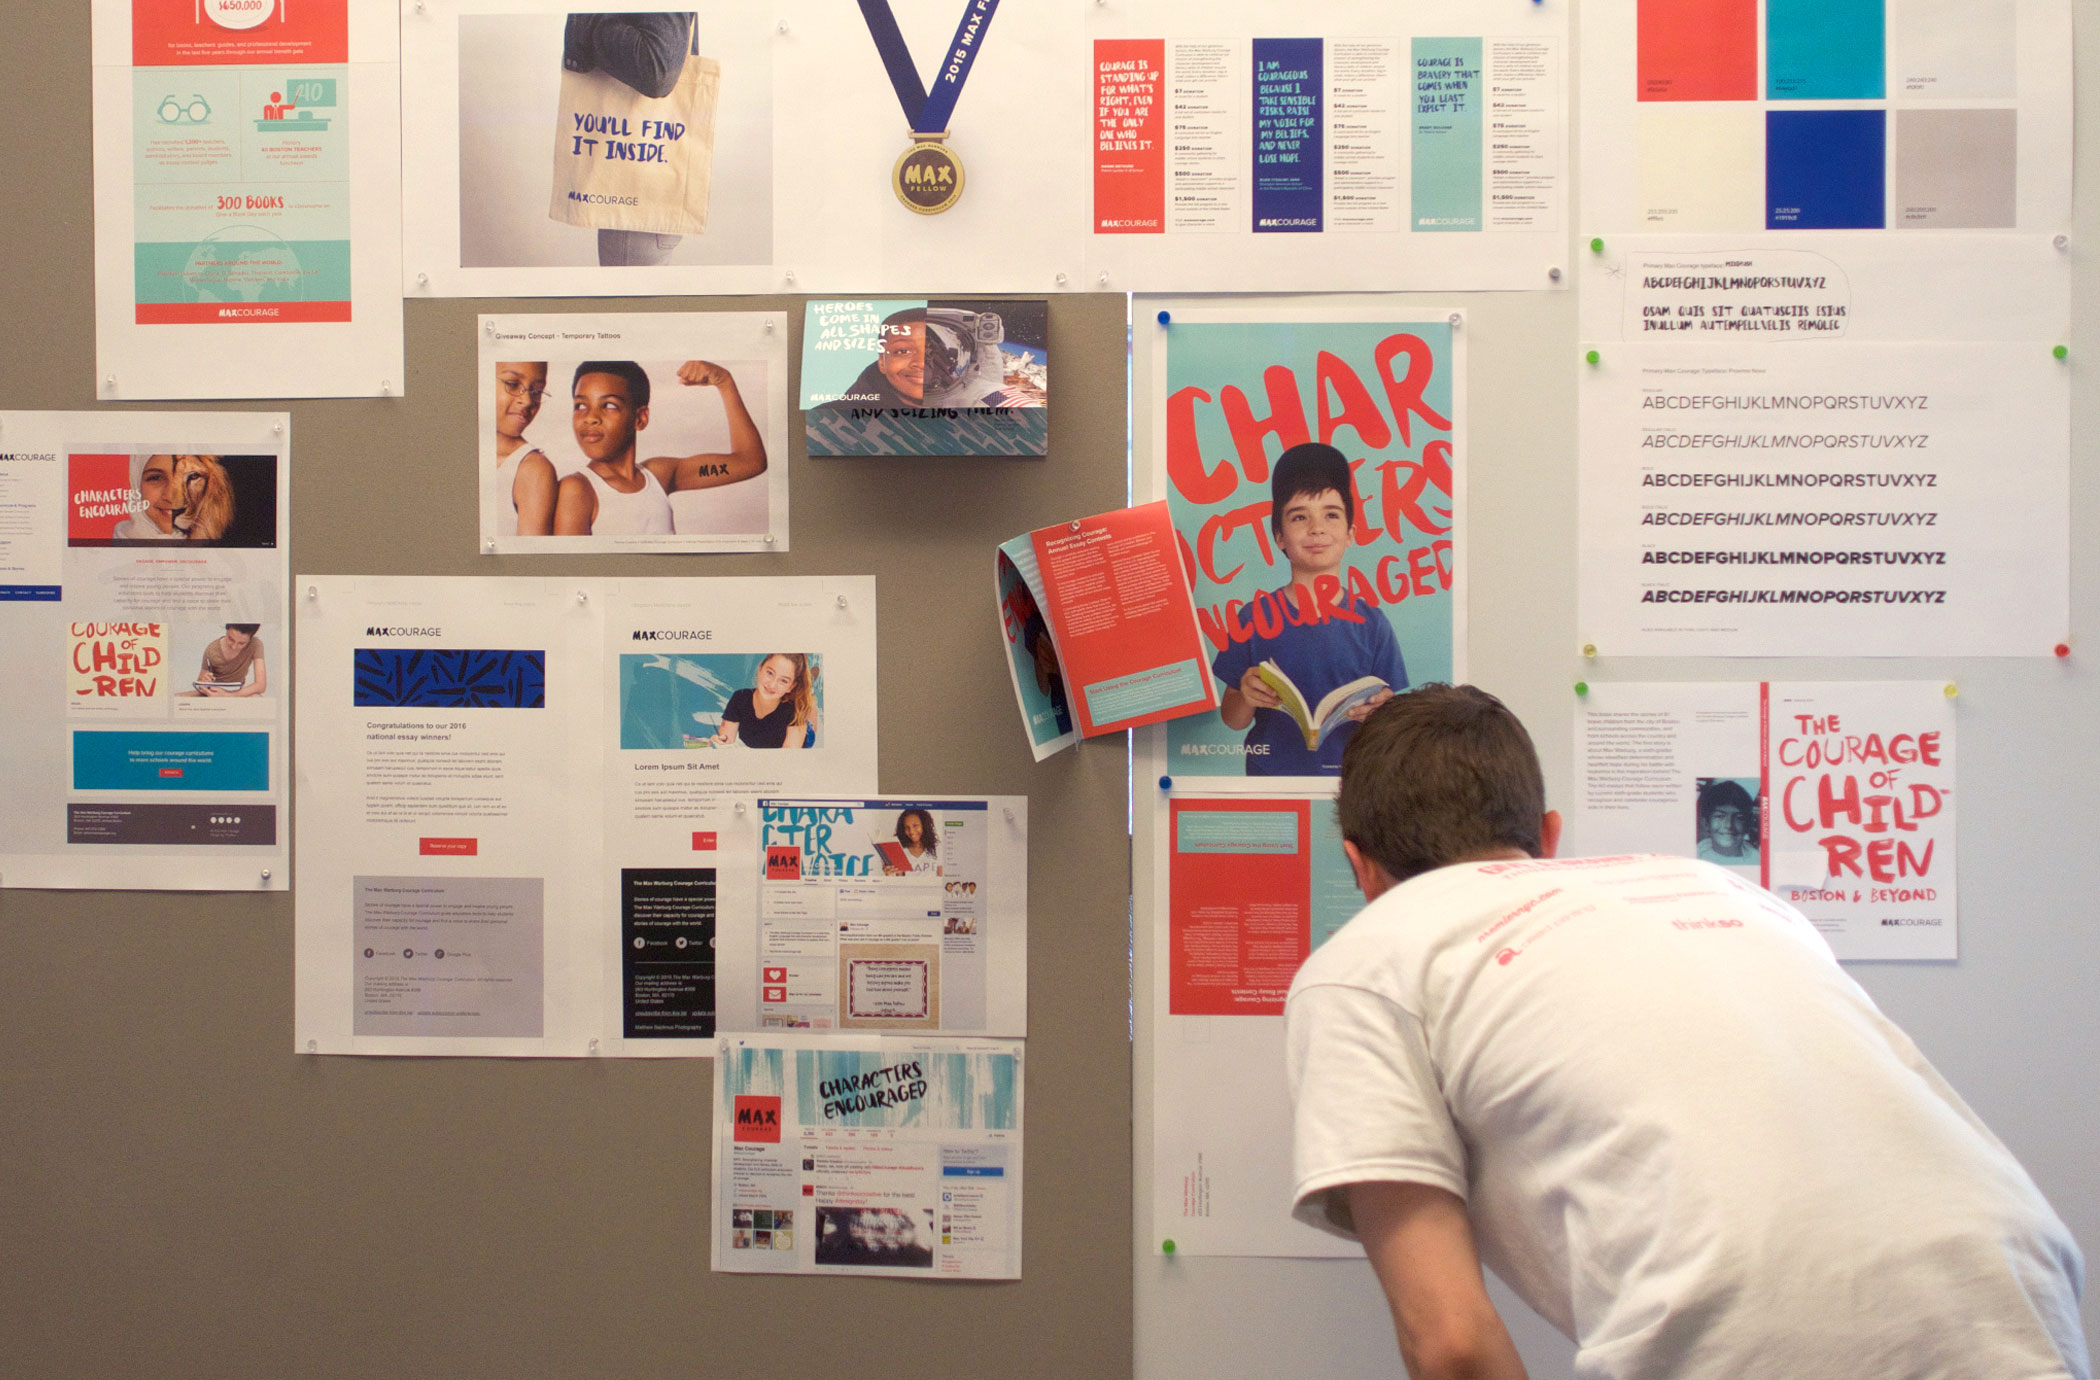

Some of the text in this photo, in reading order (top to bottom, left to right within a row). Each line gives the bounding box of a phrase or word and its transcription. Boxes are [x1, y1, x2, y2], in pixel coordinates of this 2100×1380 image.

[945, 48, 967, 83] 2015
[961, 13, 983, 46] MAX
[1100, 60, 1148, 71] COURAGE IS
[1259, 61, 1279, 71] I AM
[1417, 57, 1464, 67] COURAGE IS
[1101, 71, 1159, 83] STANDING UP
[1258, 70, 1308, 81] COURAGEOUS
[1417, 70, 1480, 80] BRAVERY THAT
[1101, 84, 1154, 95] FOR WHAT'S
[1260, 83, 1301, 94] BECAUSE I
[1418, 81, 1468, 91] COMES WHEN
[1100, 95, 1153, 106] RIGHT, EVEN
[1259, 96, 1316, 106] TAKE SENSIBLE
[1419, 94, 1465, 104] YOU LEAST
[1099, 107, 1149, 116] IF YOU ARE
[1287, 107, 1310, 115] RAISE
[1417, 104, 1447, 113] EXPECT
[574, 112, 685, 140] YOU'LL FIND
[1100, 118, 1144, 128] THE ONLY
[1259, 118, 1315, 128] MY VOICE FOR
[1100, 130, 1137, 140] ONE WHO
[1261, 131, 1273, 139] MY
[572, 136, 668, 163] IT INSIDE.
[1100, 140, 1154, 151] BELIEVES IT.
[1259, 141, 1300, 151] AND NEVER
[1259, 154, 1301, 164] LOSE HOPE.
[905, 164, 953, 185] MAX
[217, 195, 242, 210] 300
[246, 195, 284, 210] BOOKS
[568, 191, 638, 206] MAXCOURAGE
[1643, 276, 1826, 290] ABCDEFGHIJKLMNOPQRSTUVXYZ
[814, 302, 874, 314] HEROES
[1643, 306, 1670, 317] OSAM
[1678, 305, 1705, 317] QUIS
[1712, 305, 1733, 316] SIT
[1817, 305, 1846, 317] ESIUS
[819, 313, 880, 326] COME IN
[1643, 320, 1693, 331] INULLUM
[1798, 319, 1840, 330] REMOLEC
[821, 324, 911, 339] ALL SHAPES
[815, 339, 891, 354] AND SIZES.
[810, 393, 880, 401] MAXCOURAGE
[1641, 395, 1928, 410] ABCDEFGHIJKLMNOPQRSTUVXYZ
[1167, 333, 1453, 505] CHAR
[1641, 434, 1929, 448] ABCDEFGHIJKLMNOPQRSTUVXYZ
[698, 464, 729, 478] MAX
[1642, 473, 1937, 488] ABCDEFGHIJKLMNOPQRSTUVXYZ
[74, 488, 142, 505] CHARACTERS
[79, 500, 150, 519] ENCOURAGED
[1641, 512, 1938, 527] ABCDEFGHIJKLMNOPQRSTUVXYZ
[1045, 533, 1081, 547] Recognizing
[1048, 534, 1112, 555] Annual Essay Contests
[1642, 551, 1946, 565] ABCDEFGHIJKLMNOPQRSTUVXYZ
[1641, 590, 1947, 604] ABCDEFGHIJKLMNOPQRSTUVXYZ
[72, 623, 161, 638] COURAGE
[366, 627, 441, 637] MAXCOURAGE
[632, 630, 712, 641] MAXCOURAGE
[121, 639, 138, 650] OF
[73, 641, 161, 674] CHILD
[367, 722, 424, 730] Congratulations
[1794, 714, 1840, 735] THE
[1180, 743, 1271, 756] MAXCOURAGE
[1779, 730, 1941, 770] COURAGE
[661, 763, 685, 771] Ipsum
[1869, 768, 1901, 790] OF
[769, 856, 798, 868] MAX
[1818, 835, 1934, 884] REN
[1791, 888, 1936, 903] BOSTON & BEYOND
[1671, 918, 1745, 931] thinkso
[1881, 919, 1942, 927] MAXCOURAGE
[820, 1060, 922, 1100] CHARACTERS
[824, 1080, 928, 1120] ENCOURAGED
[738, 1108, 777, 1126] MAX
